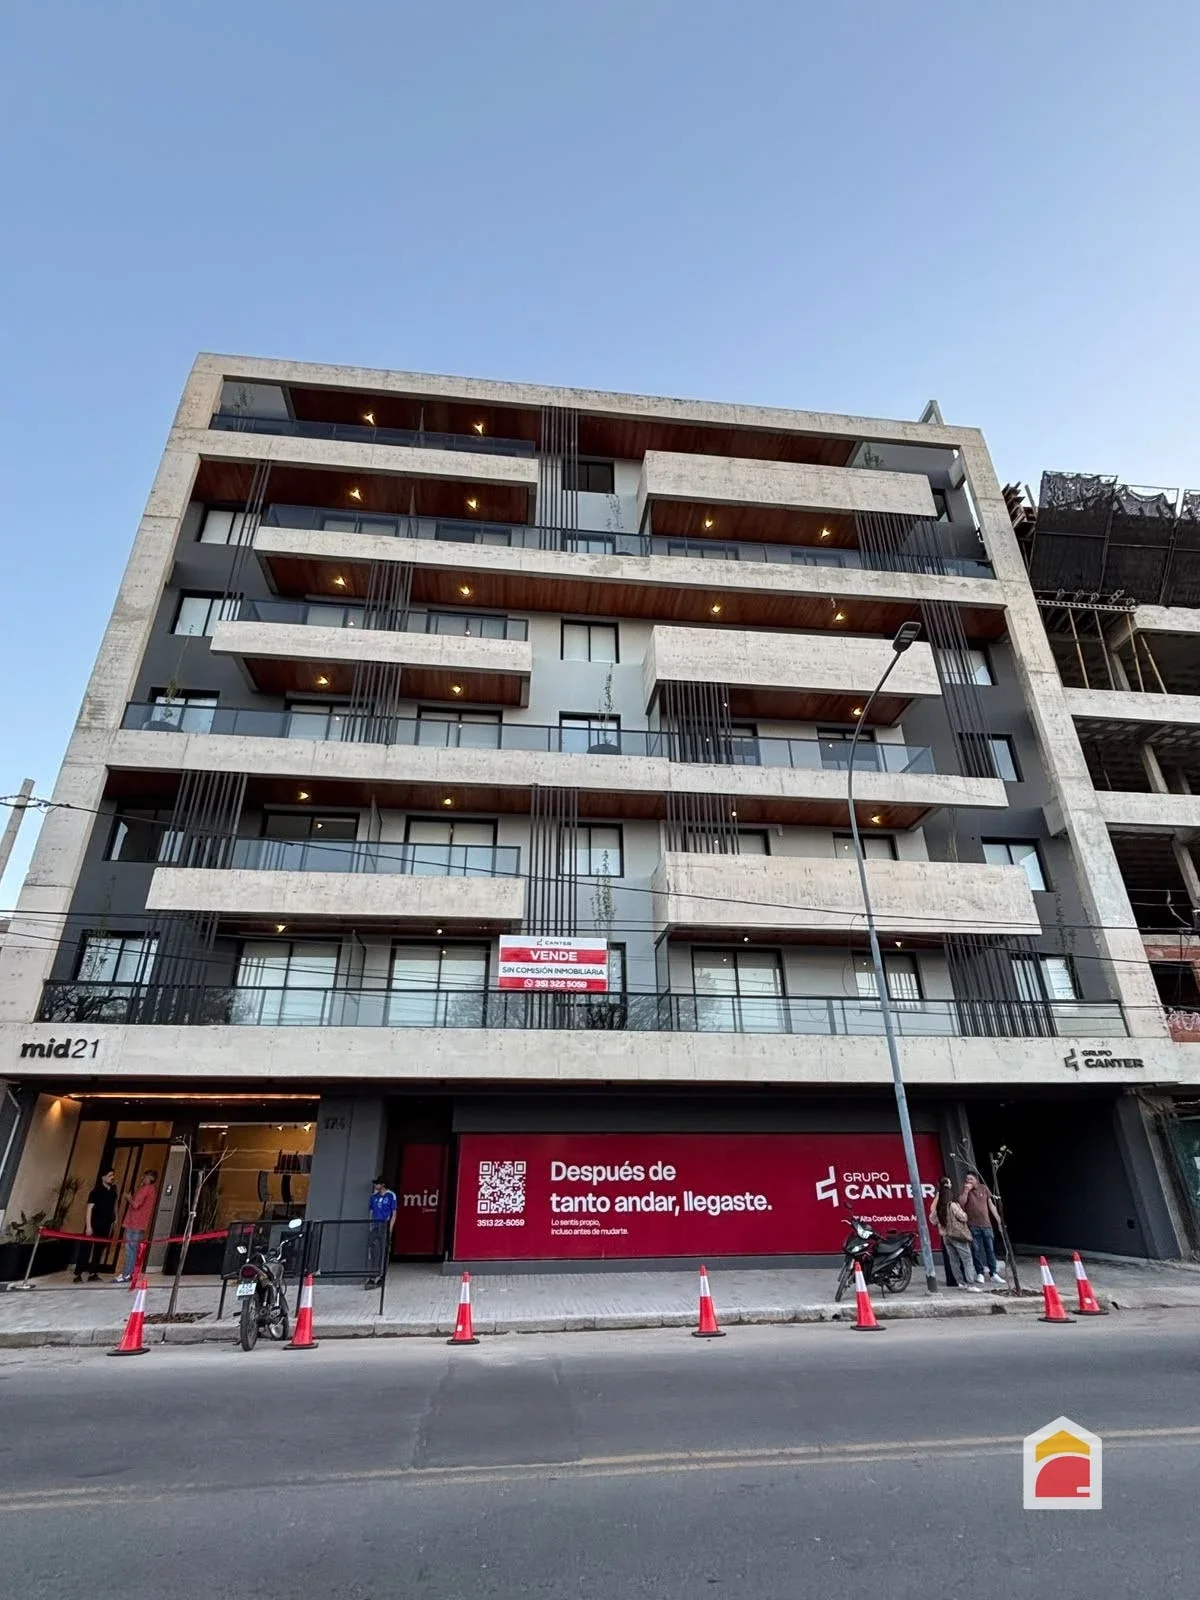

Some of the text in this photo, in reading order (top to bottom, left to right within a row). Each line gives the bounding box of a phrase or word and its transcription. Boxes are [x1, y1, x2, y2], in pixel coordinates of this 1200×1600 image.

[530, 950, 578, 961] VENDE
[516, 966, 553, 974] COMISIÓN
[554, 967, 604, 975] INMOBILIARIA
[535, 980, 549, 988] 351
[549, 980, 566, 988] 322
[1084, 1058, 1145, 1068] CANTER
[550, 1159, 677, 1186] Después de
[843, 1172, 890, 1182] GRUPO
[403, 1189, 439, 1207] mid
[550, 1190, 773, 1217] tanto andar, llegaste.
[476, 1218, 526, 1227] 3513 22-5059
[551, 1218, 559, 1226] Lo
[551, 1228, 573, 1236] incluso
[573, 1228, 591, 1236] antes
[591, 1228, 600, 1236] de
